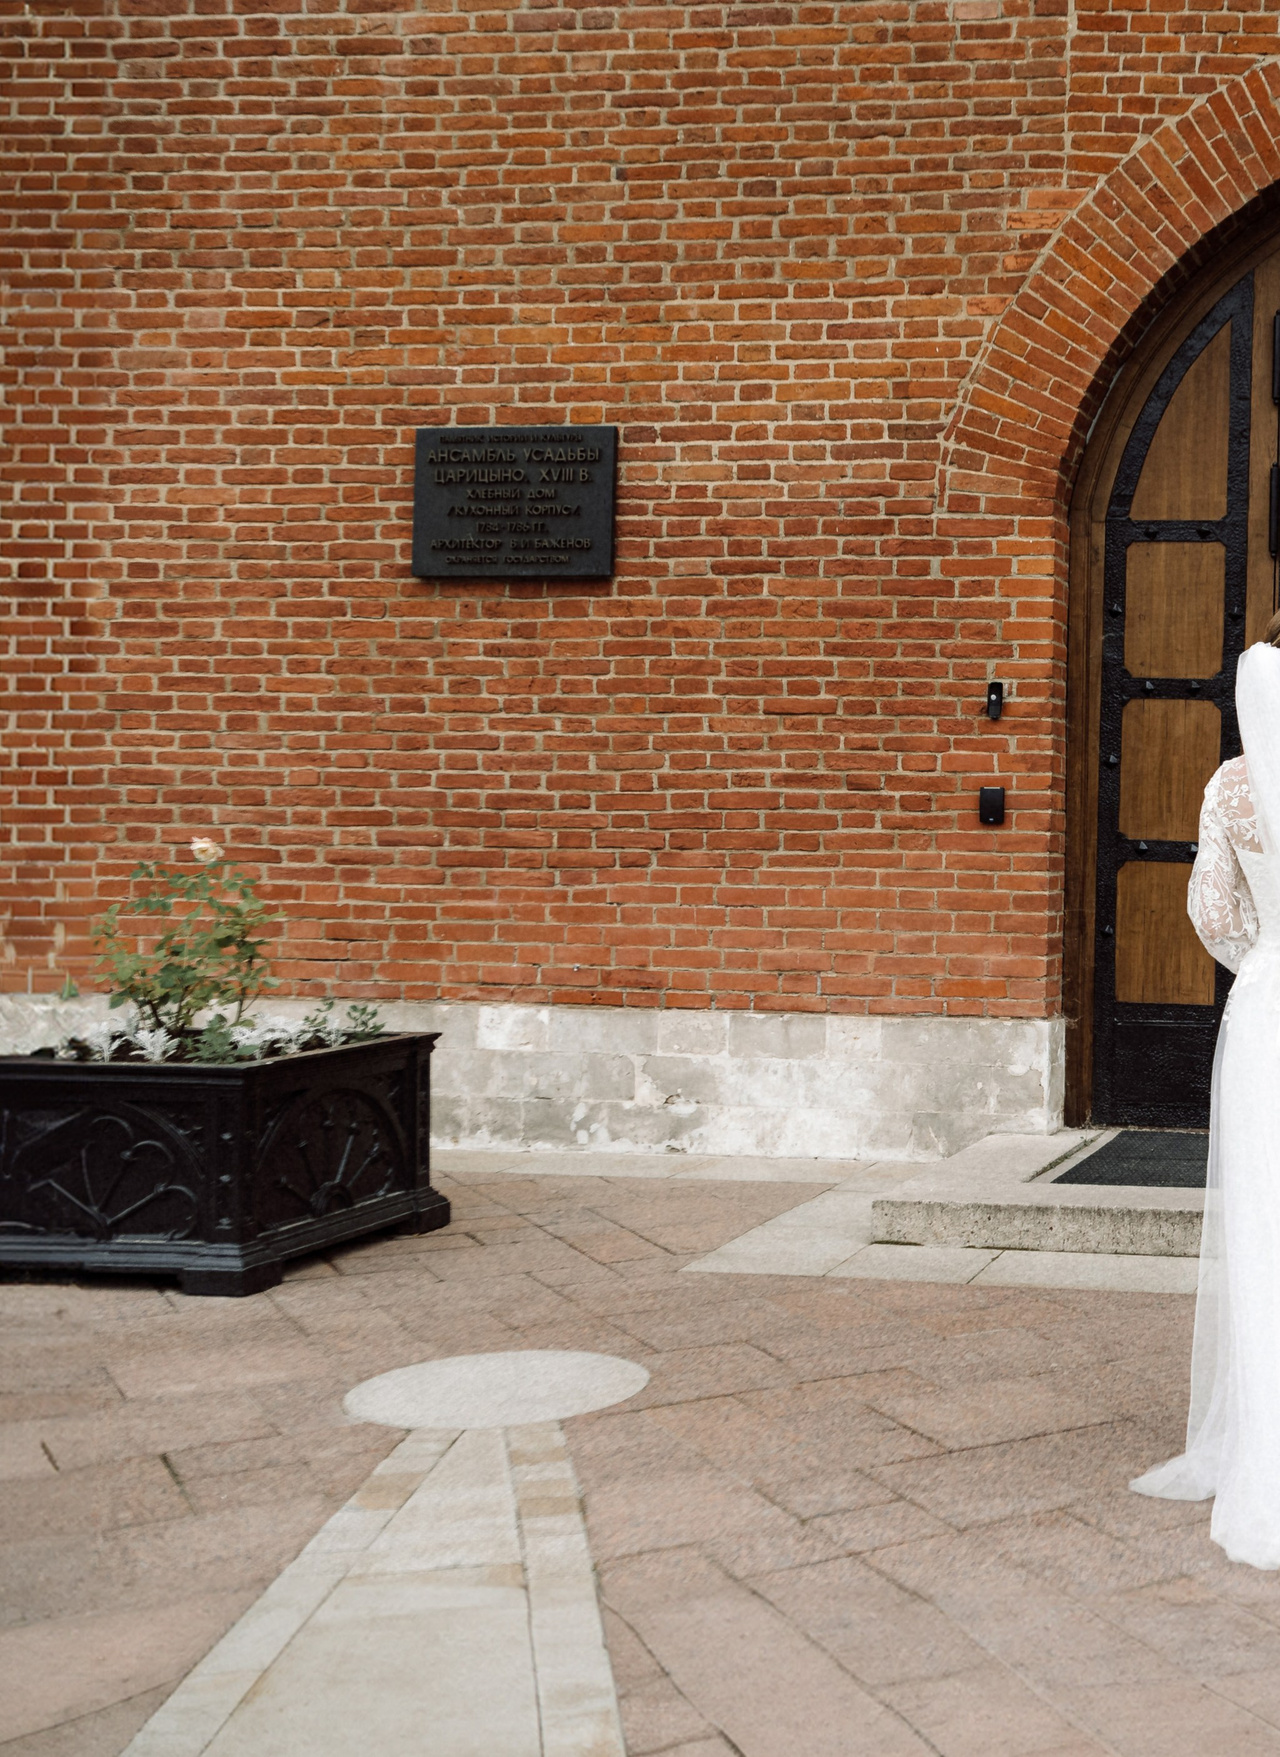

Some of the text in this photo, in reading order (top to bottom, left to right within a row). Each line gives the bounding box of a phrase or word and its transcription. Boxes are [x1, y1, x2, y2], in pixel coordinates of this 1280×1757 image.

[427, 447, 600, 463] АНСАМБЛЬ УСАДЬБЫ
[538, 467, 574, 482] XVIII
[465, 488, 556, 499] ХЛЕБНЫЙ ДОМ
[430, 538, 503, 549] АРХИТЕКТОР
[534, 538, 592, 549] БАЖЕНОВ
[502, 554, 570, 564] ГОСУДАРСТВОМ
